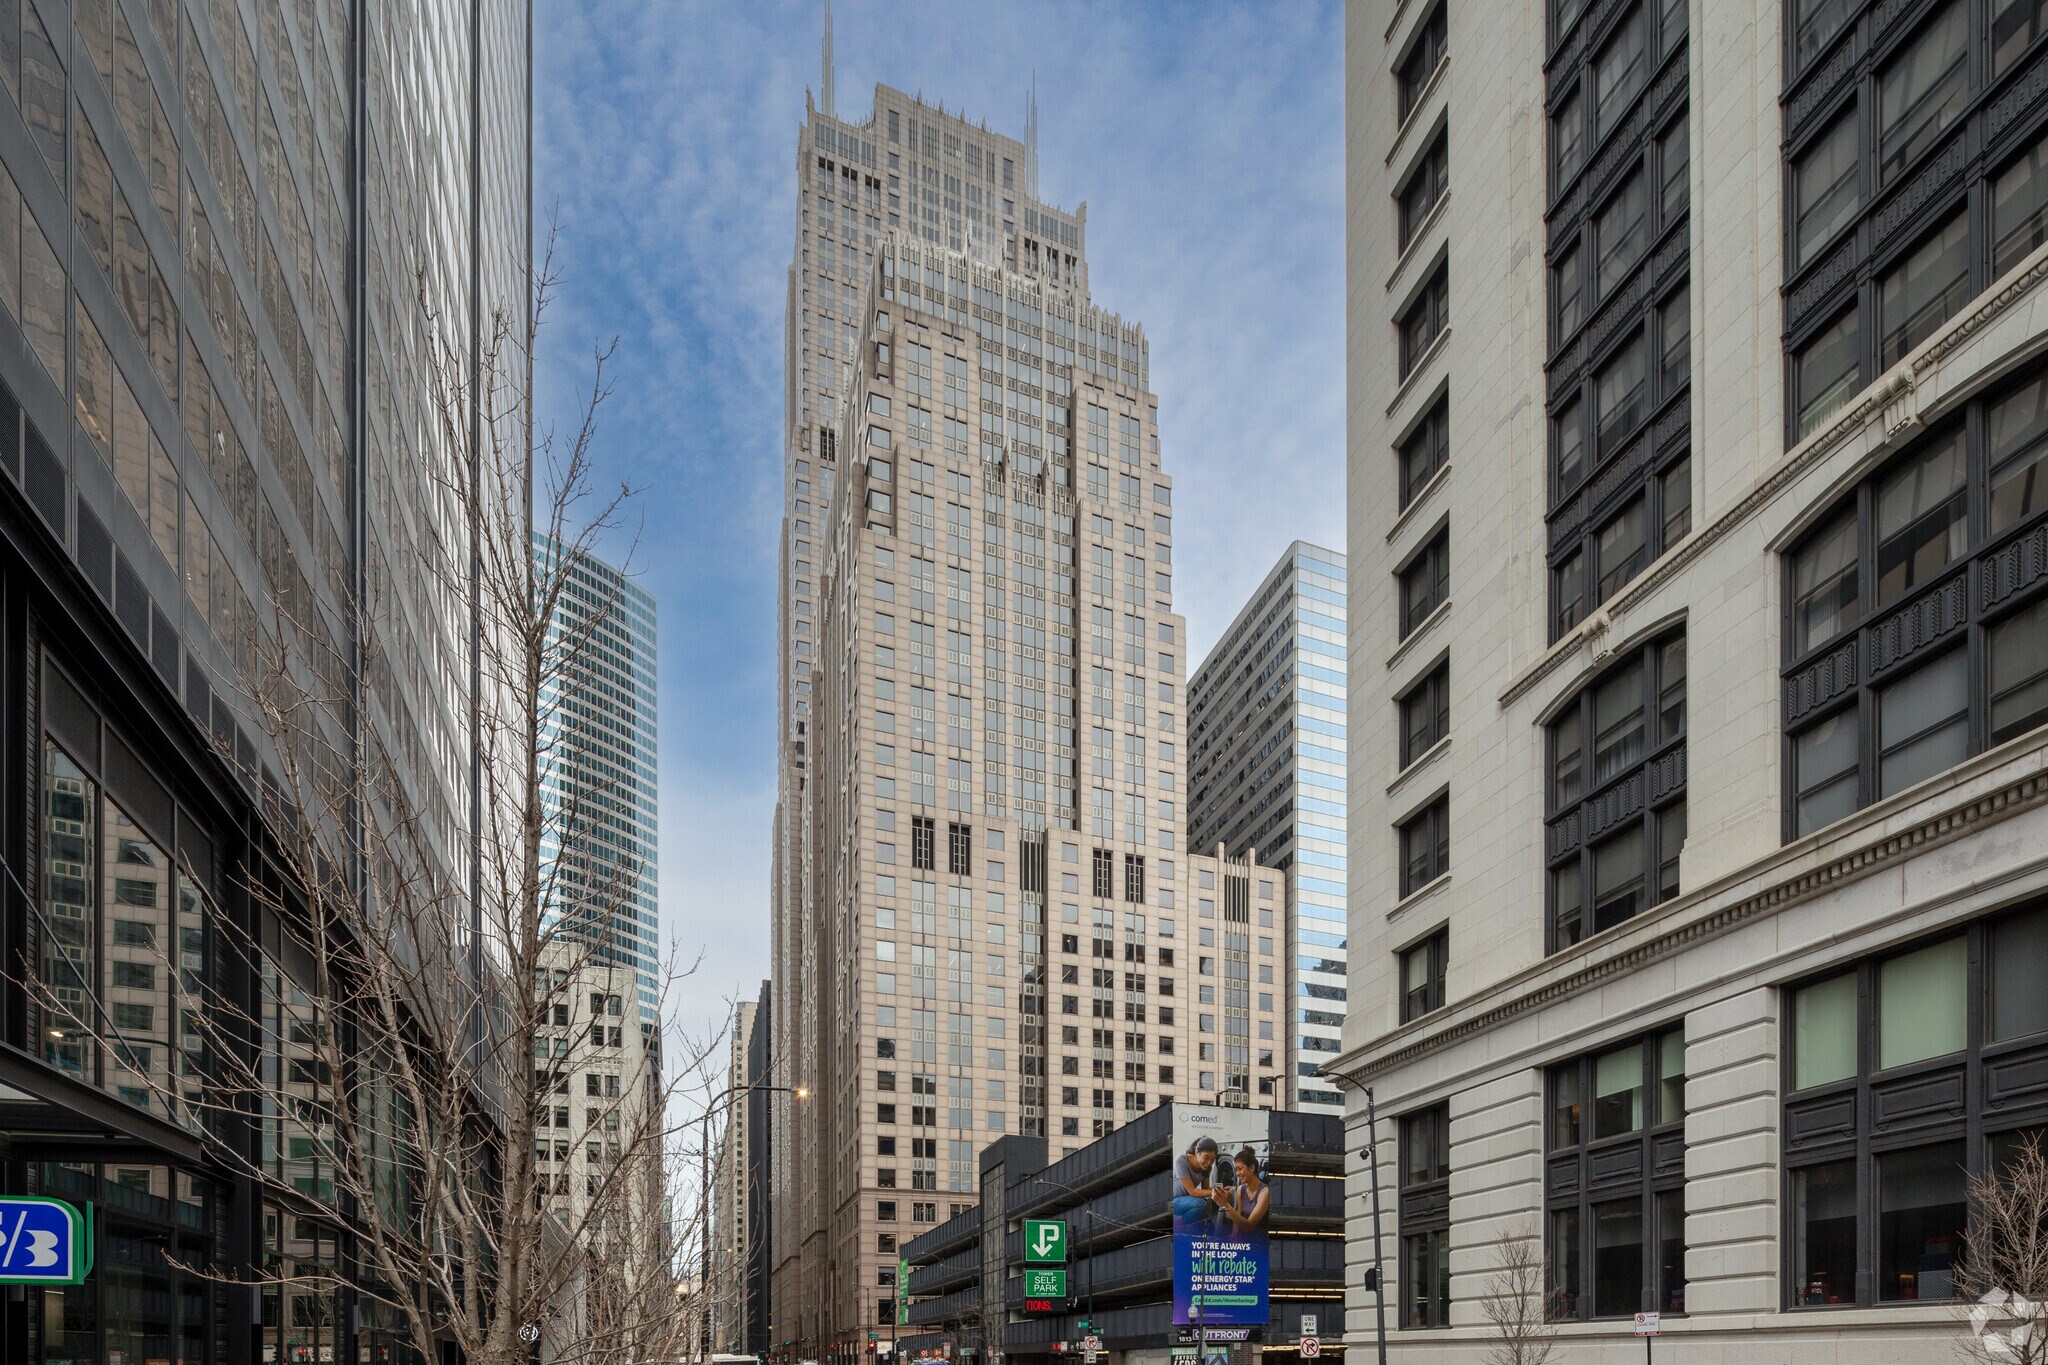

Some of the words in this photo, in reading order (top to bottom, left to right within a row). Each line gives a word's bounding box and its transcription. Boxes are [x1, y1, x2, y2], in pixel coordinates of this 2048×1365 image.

[1191, 1115, 1218, 1124] comed
[1220, 1242, 1251, 1251] ALWAYS
[1191, 1250, 1200, 1258] IN
[1217, 1251, 1238, 1259] LOOP
[1191, 1255, 1216, 1275] with
[1219, 1256, 1257, 1275] rebates
[1034, 1276, 1057, 1284] SELF
[1191, 1275, 1203, 1283] ON
[1204, 1275, 1234, 1283] ENERGY
[1033, 1284, 1058, 1292] PARK
